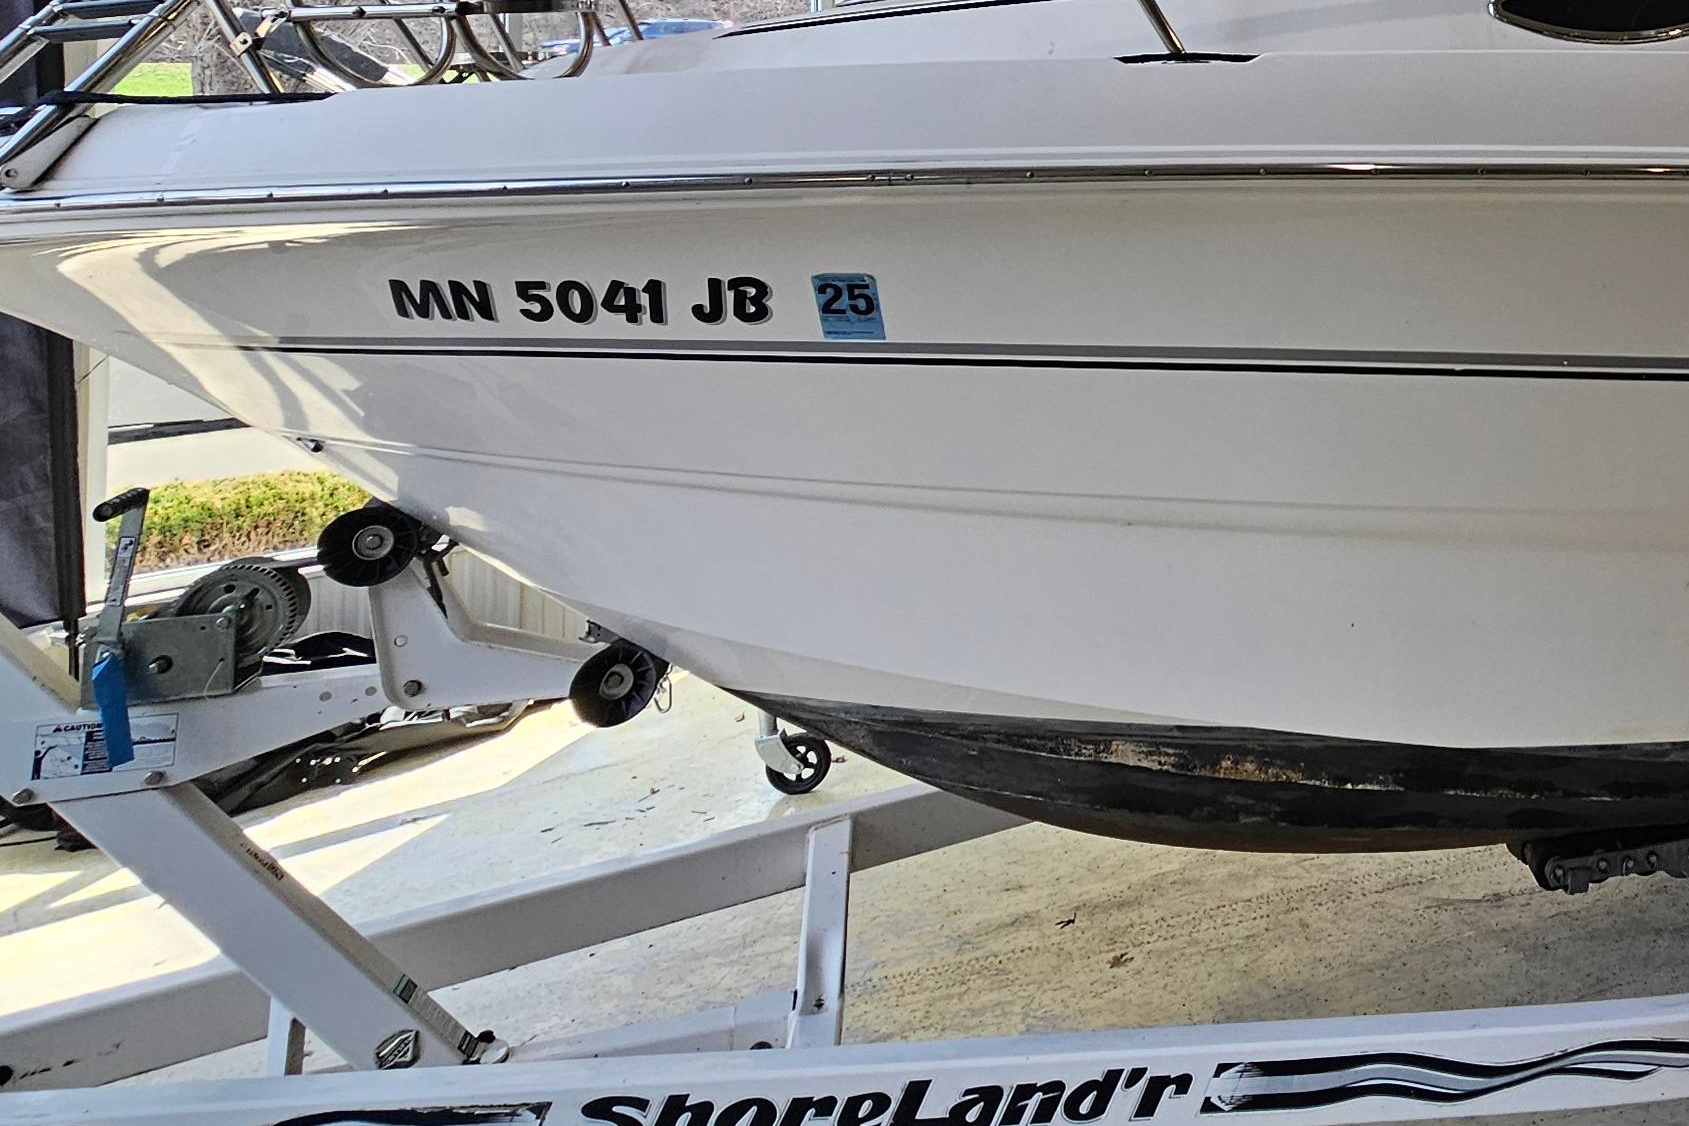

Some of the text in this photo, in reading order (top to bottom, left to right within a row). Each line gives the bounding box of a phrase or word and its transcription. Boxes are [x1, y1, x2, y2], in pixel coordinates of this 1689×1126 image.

[388, 276, 775, 327] MN 5041 JB
[817, 282, 875, 316] 25
